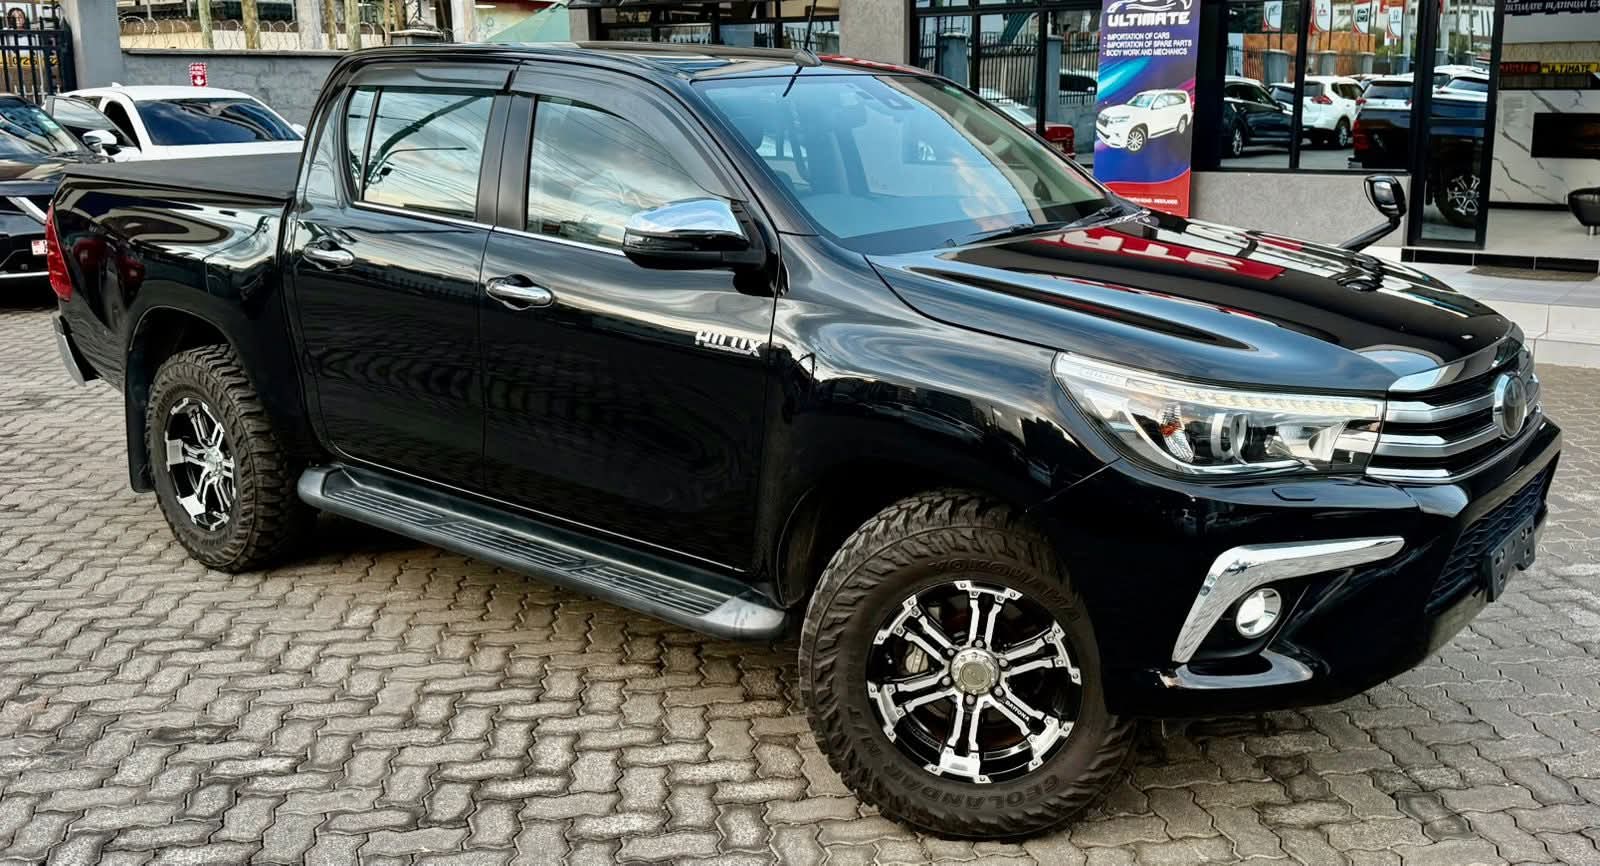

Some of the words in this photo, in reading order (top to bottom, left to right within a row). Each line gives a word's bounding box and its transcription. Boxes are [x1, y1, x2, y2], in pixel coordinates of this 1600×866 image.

[1107, 12, 1190, 27] ULTIMATE
[1153, 47, 1187, 55] MECHANICS
[694, 330, 762, 357] HILUX
[1005, 700, 1030, 721] DAYTONA
